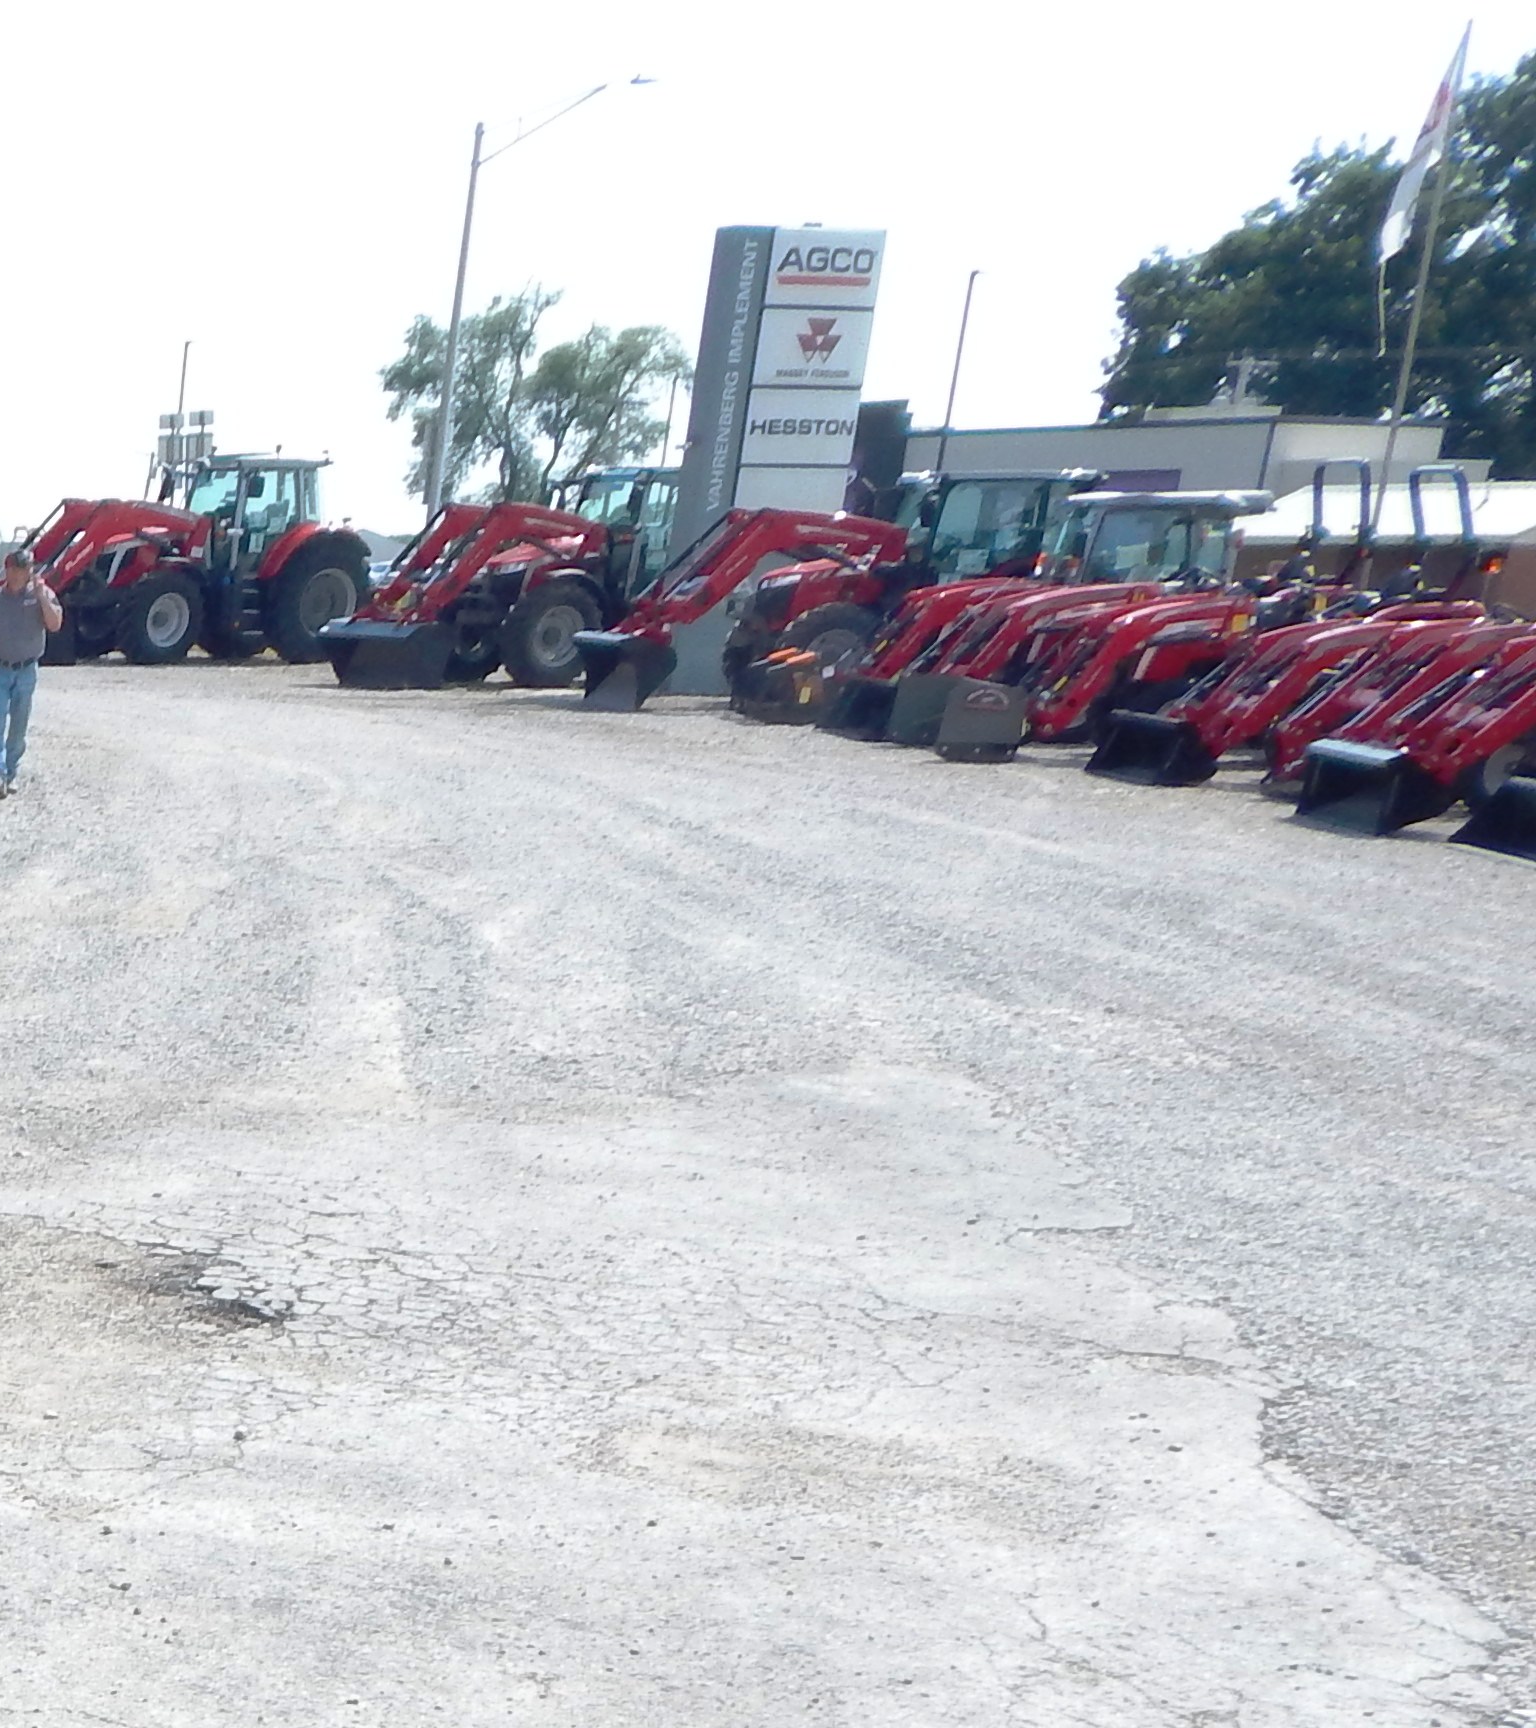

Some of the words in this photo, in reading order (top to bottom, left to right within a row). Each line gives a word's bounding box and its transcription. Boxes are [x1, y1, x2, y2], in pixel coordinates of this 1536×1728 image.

[776, 247, 874, 273] AGCO
[706, 370, 740, 512] VAHRENBERG
[728, 237, 759, 364] IMPLEMENT
[749, 419, 855, 436] HESSTON
